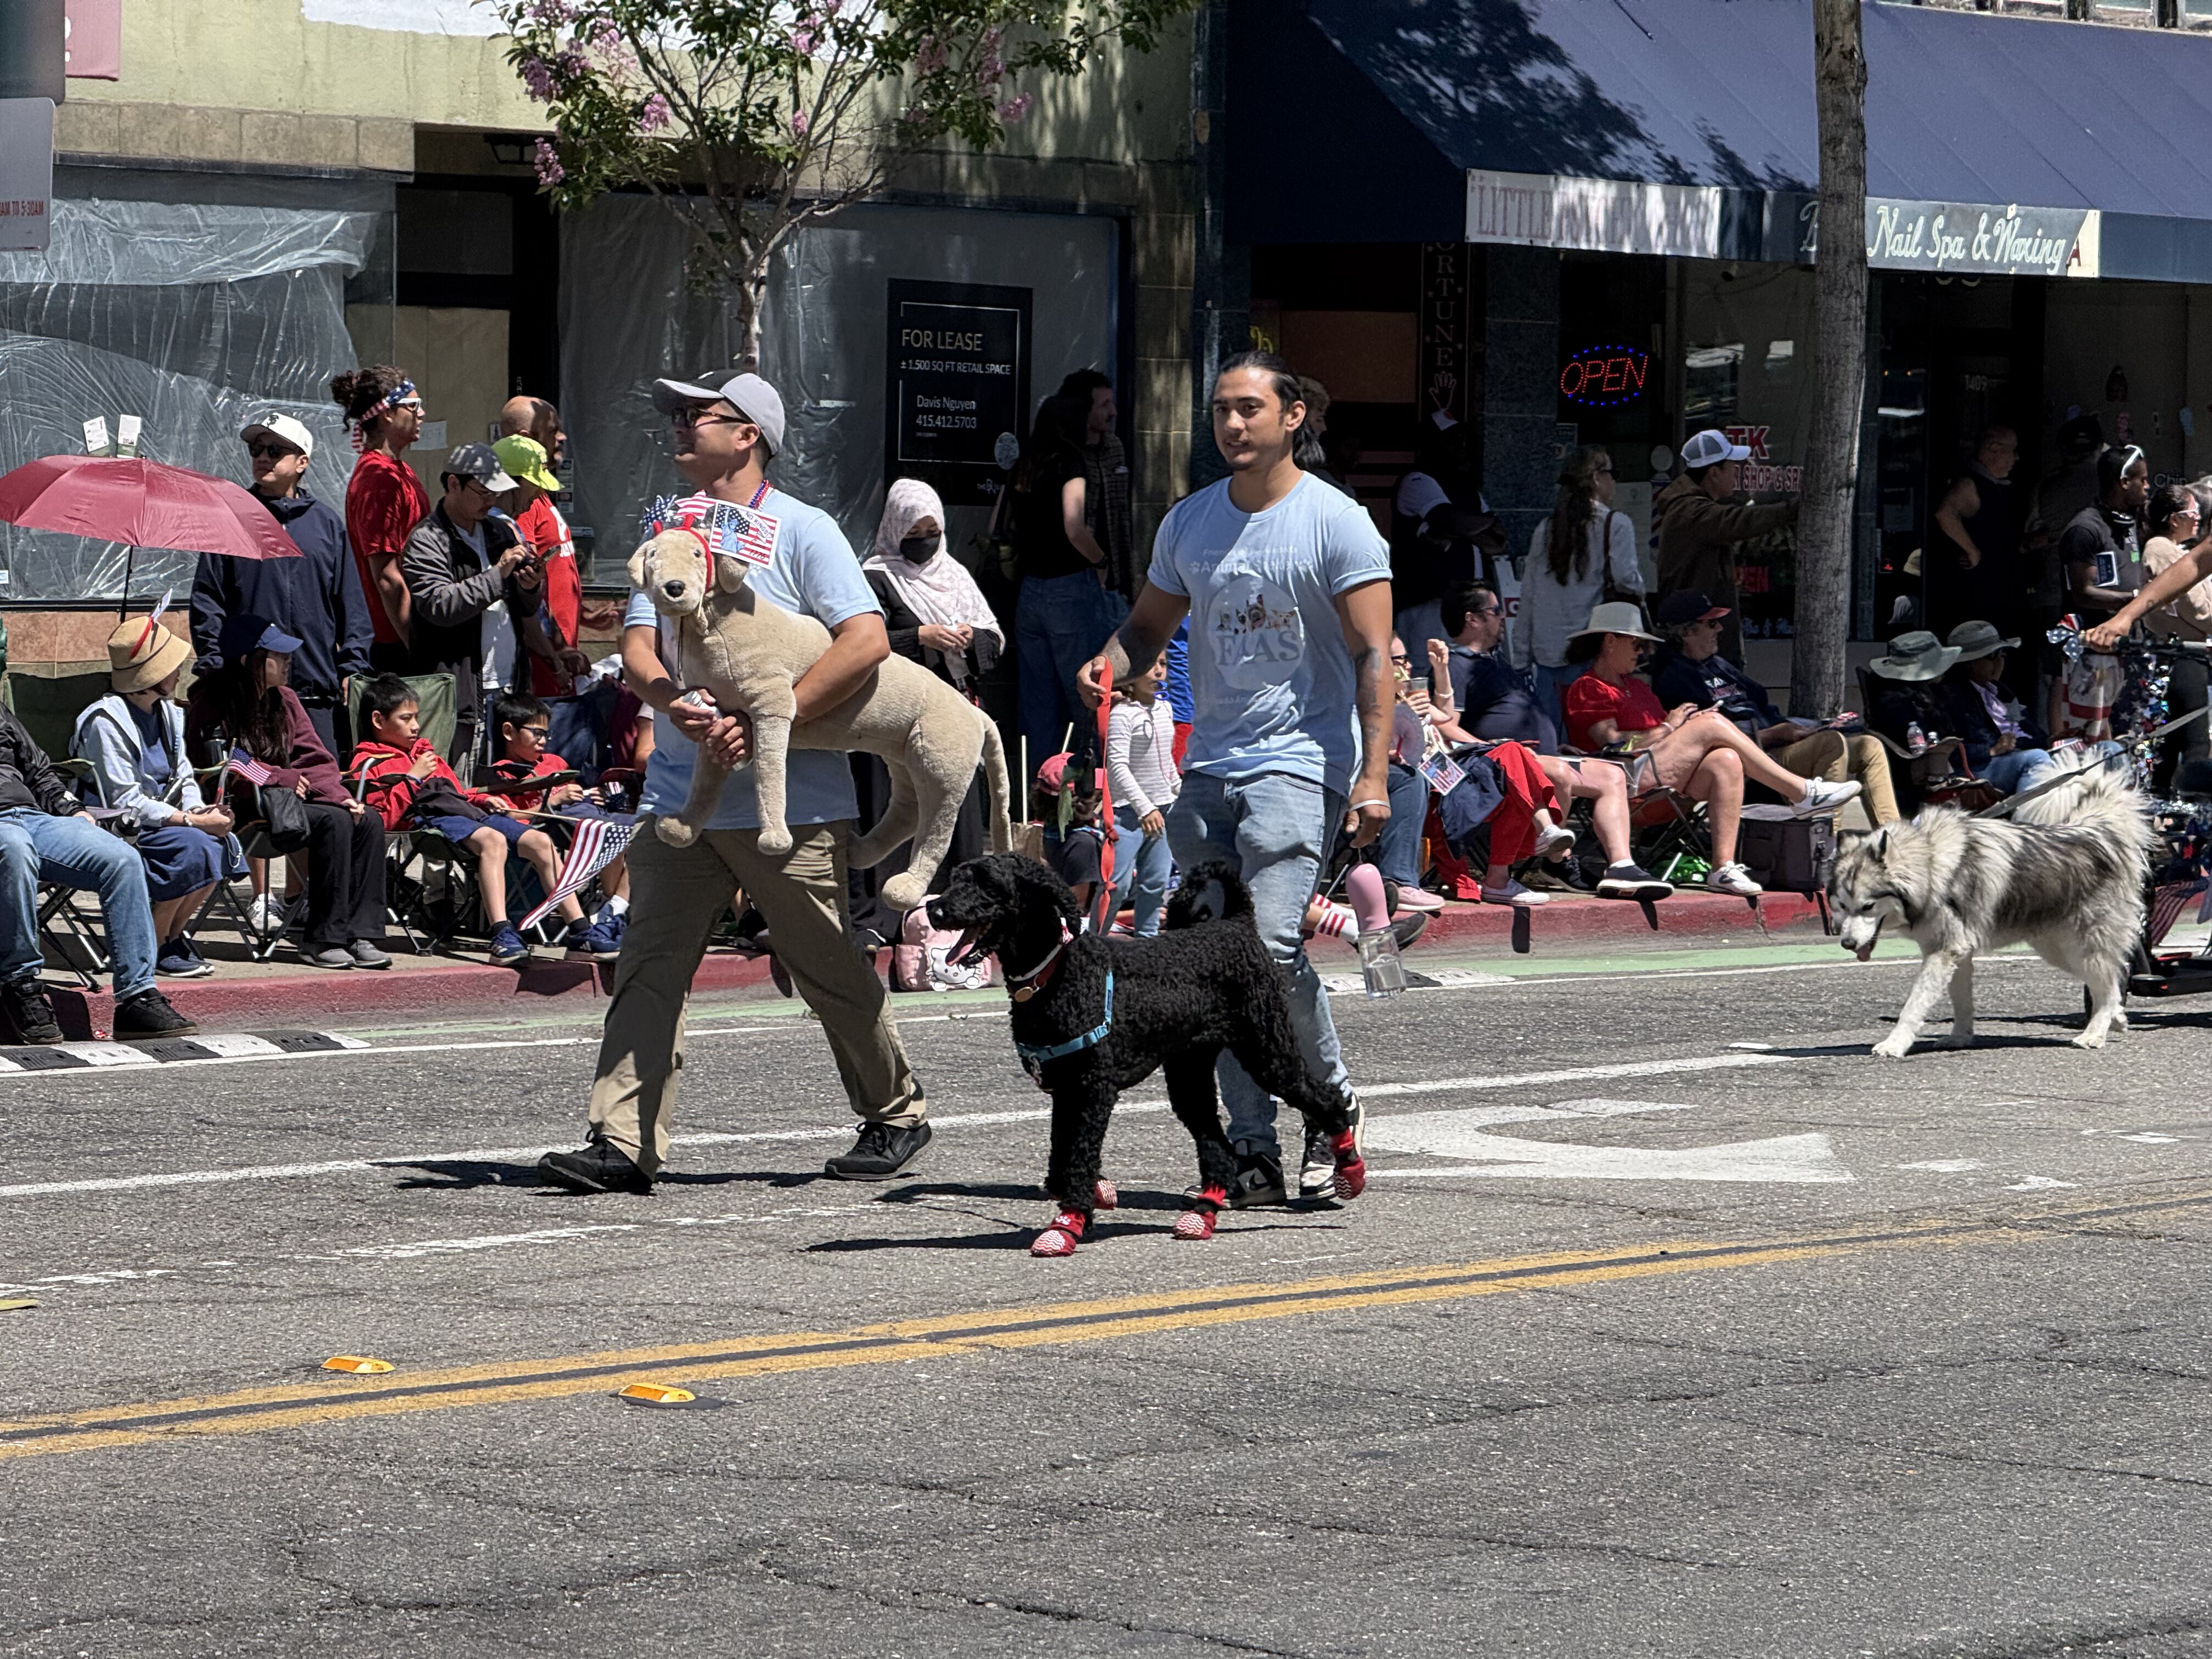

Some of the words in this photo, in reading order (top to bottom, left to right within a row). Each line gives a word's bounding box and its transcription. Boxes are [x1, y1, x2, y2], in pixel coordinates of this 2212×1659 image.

[12, 201, 19, 215] TO
[1867, 206, 1924, 258] Nail
[1927, 215, 1965, 268] Spa
[1972, 212, 1991, 261] &
[1994, 217, 2067, 274] Waxing
[902, 329, 933, 348] FOR
[937, 331, 983, 351] LEASE
[932, 360, 944, 373] SQ
[945, 361, 956, 371] FT
[957, 362, 984, 374] RETAIL
[985, 363, 1012, 375] SPACE
[1560, 356, 1648, 394] OPEN
[916, 394, 941, 408] Davis
[943, 396, 977, 411] Nguyen
[1743, 465, 1771, 492] SHOP
[1774, 465, 1784, 492] &
[745, 511, 754, 520] NO
[754, 518, 769, 535] KINGS
[749, 549, 765, 560] 1776
